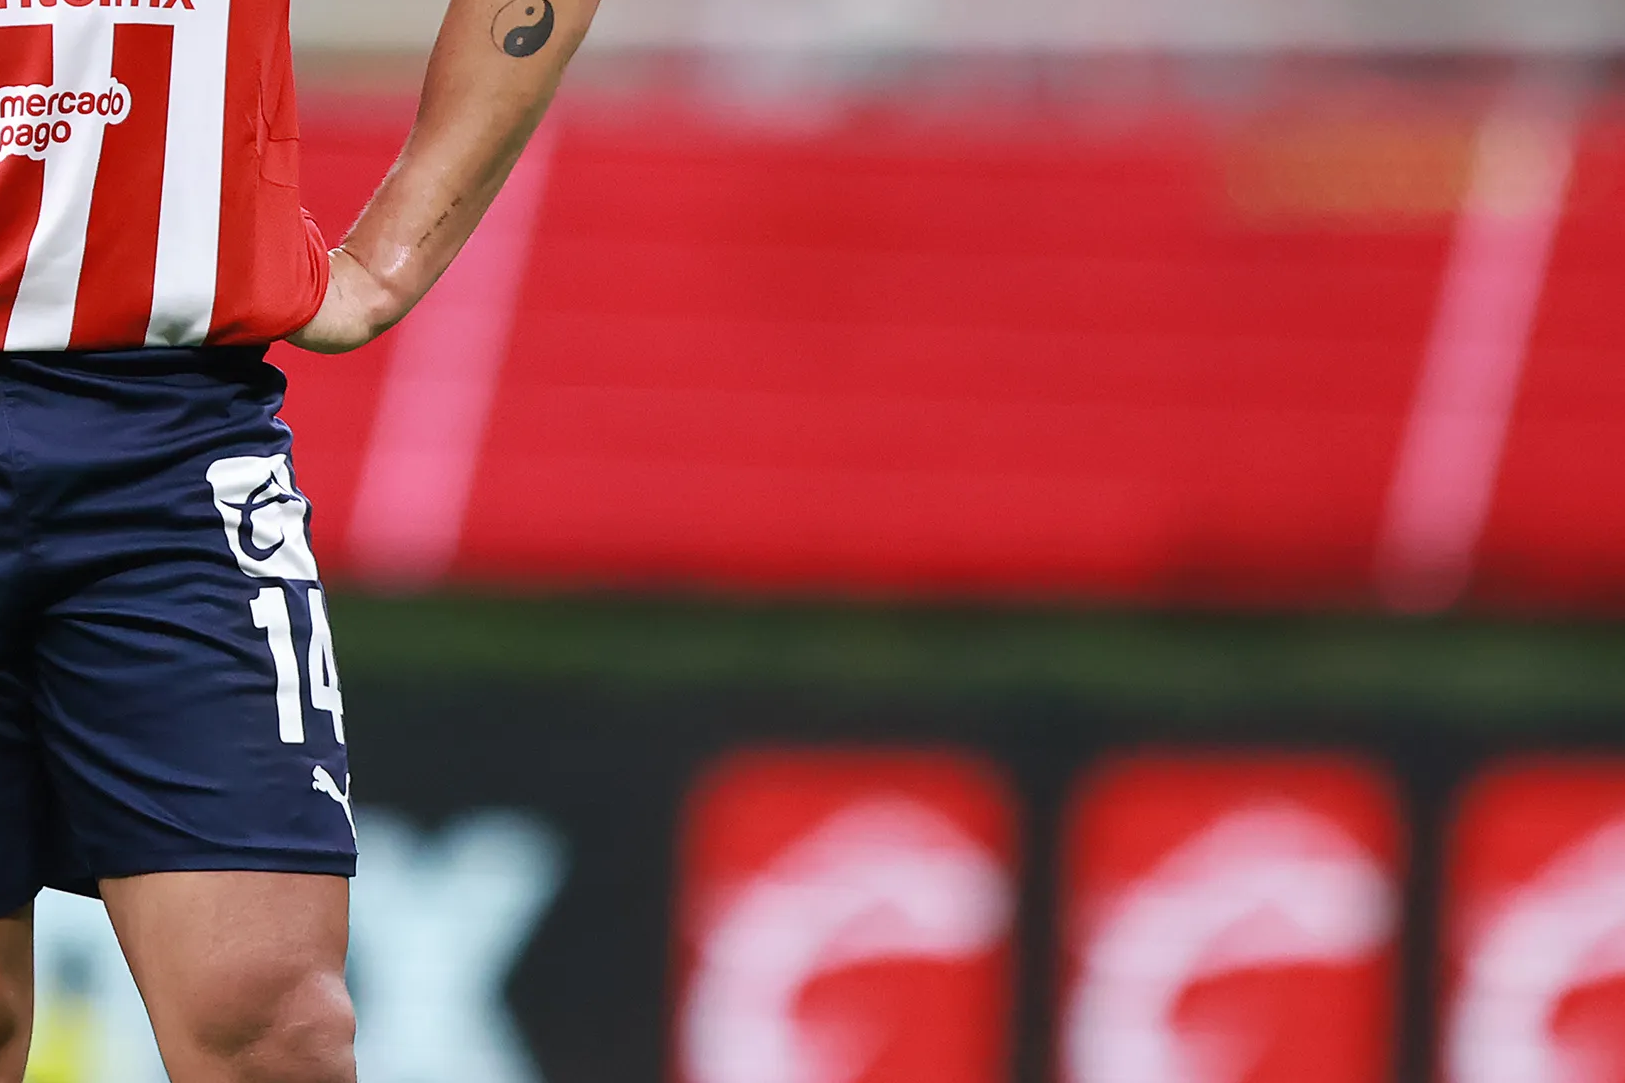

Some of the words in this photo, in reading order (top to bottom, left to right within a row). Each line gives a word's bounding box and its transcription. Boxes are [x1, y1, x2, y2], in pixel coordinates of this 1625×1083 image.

[0, 86, 124, 119] mercado
[0, 120, 72, 152] pago
[250, 586, 345, 745] 14
